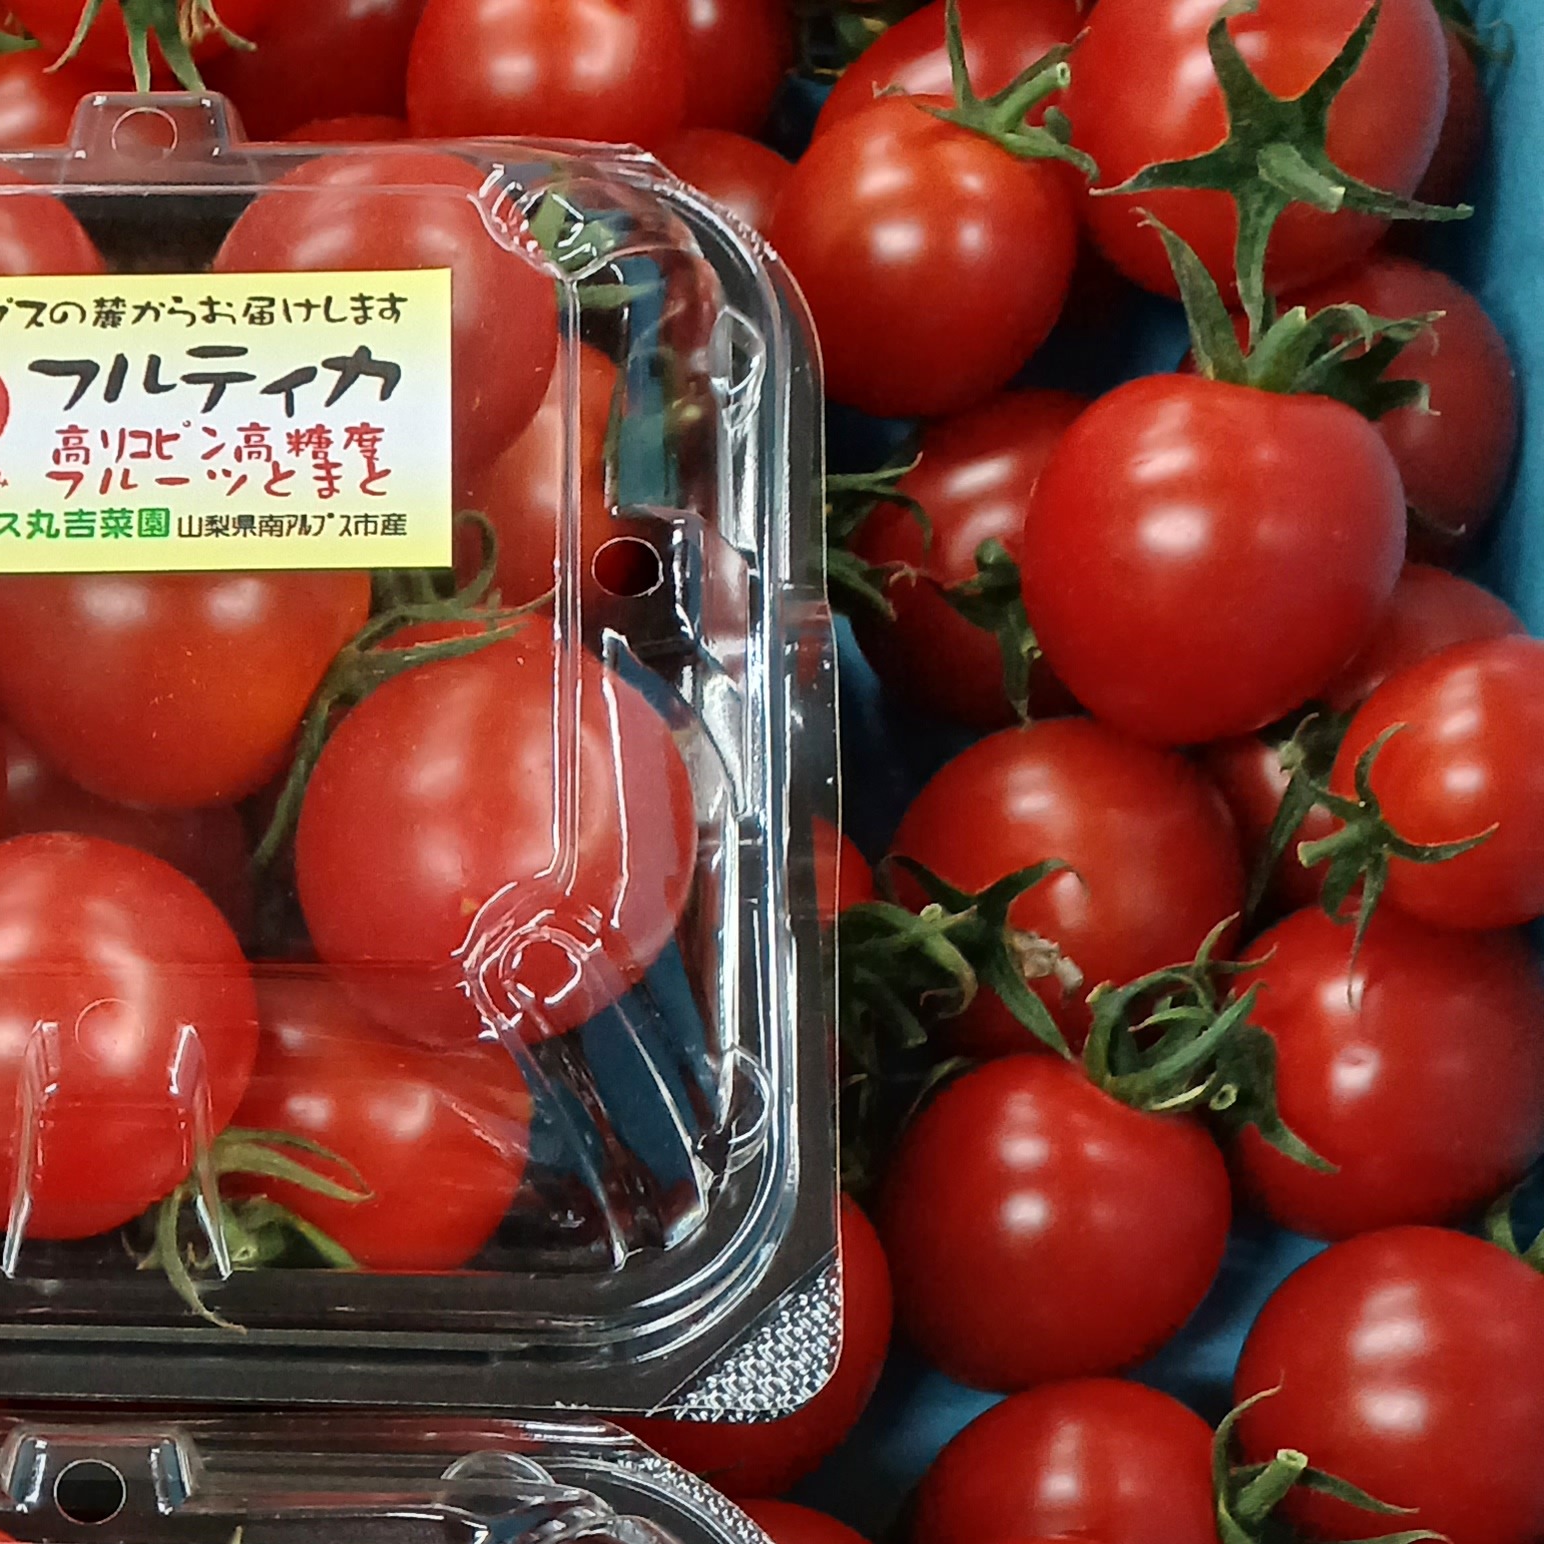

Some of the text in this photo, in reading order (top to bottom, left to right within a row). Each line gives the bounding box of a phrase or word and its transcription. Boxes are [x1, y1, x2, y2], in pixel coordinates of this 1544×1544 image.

[28, 345, 402, 417] フルティカ
[54, 421, 386, 464] 高リコピン高糖度
[48, 461, 393, 500] フルーツとまと
